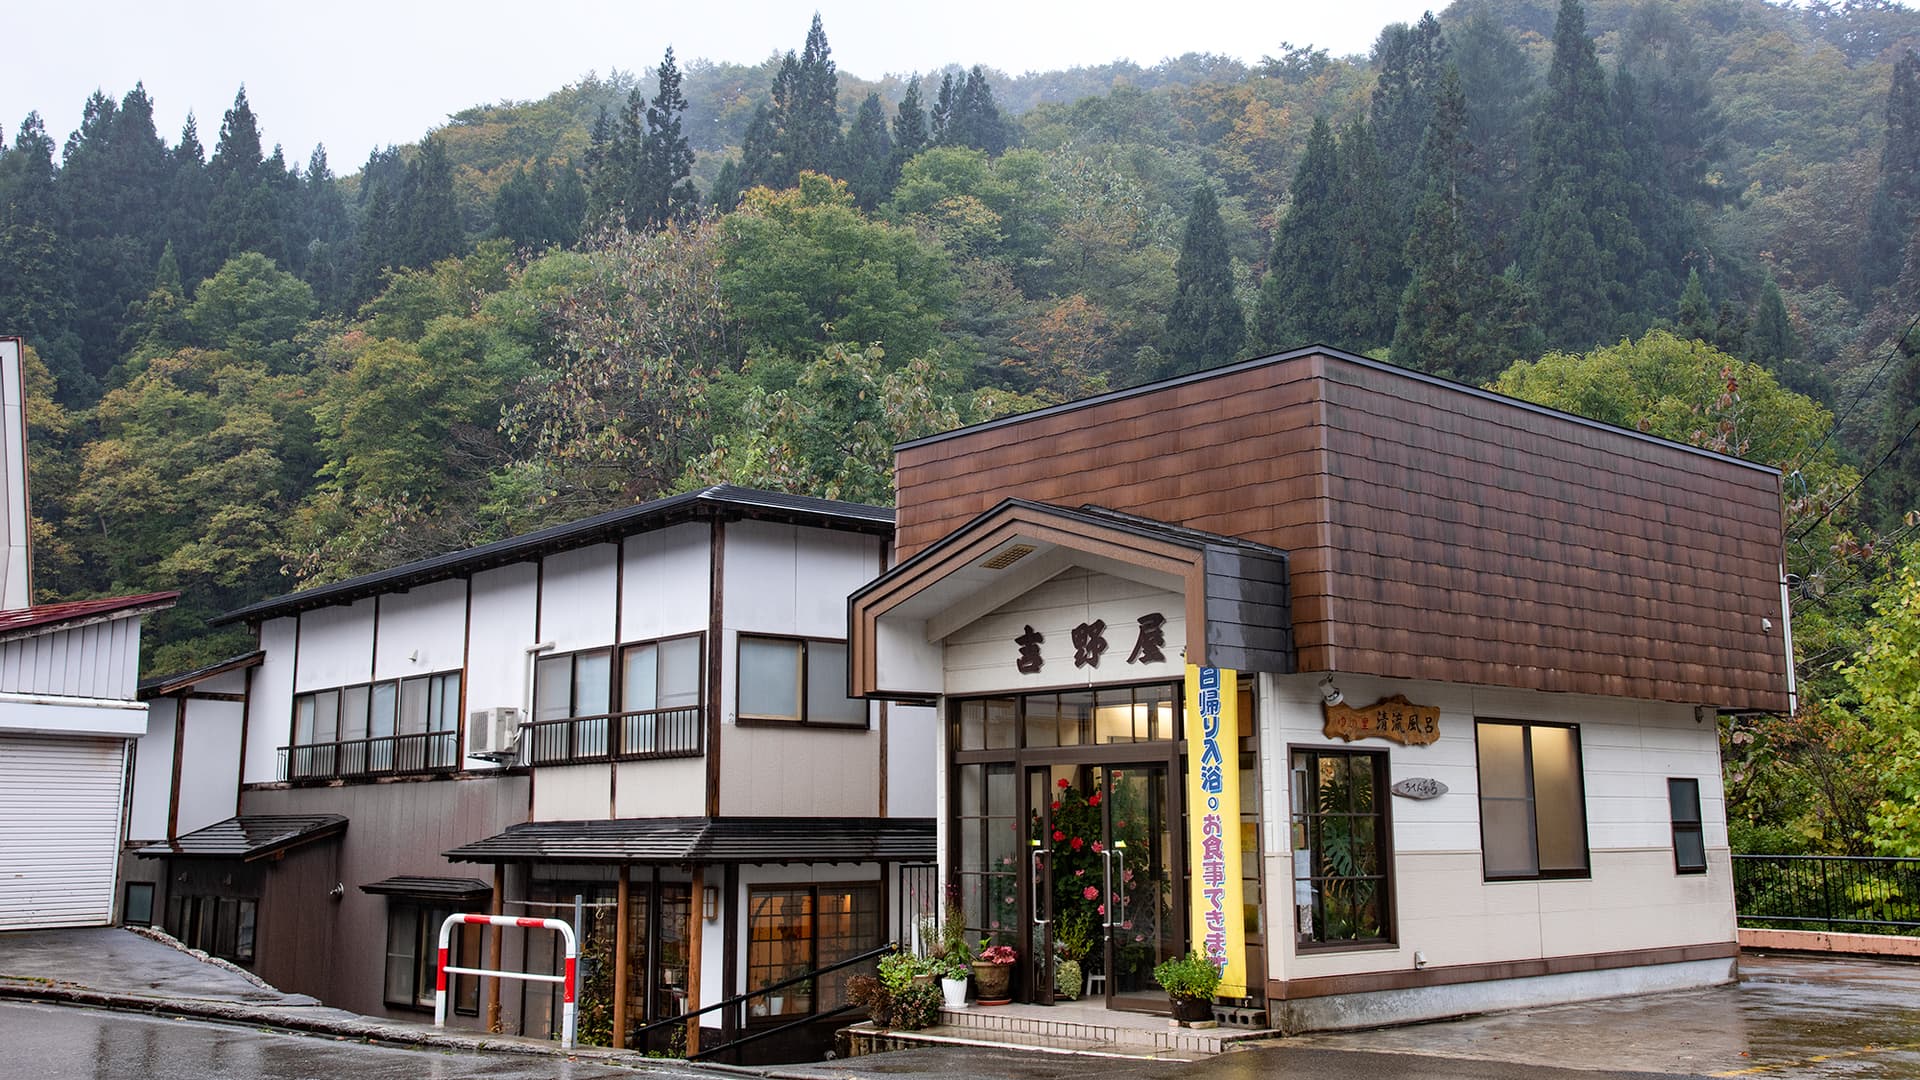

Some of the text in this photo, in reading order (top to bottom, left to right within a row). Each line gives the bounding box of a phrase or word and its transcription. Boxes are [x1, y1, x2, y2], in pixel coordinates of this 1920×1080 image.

[1015, 612, 1167, 675] 吉野屋
[1376, 710, 1435, 734] 清流風呂
